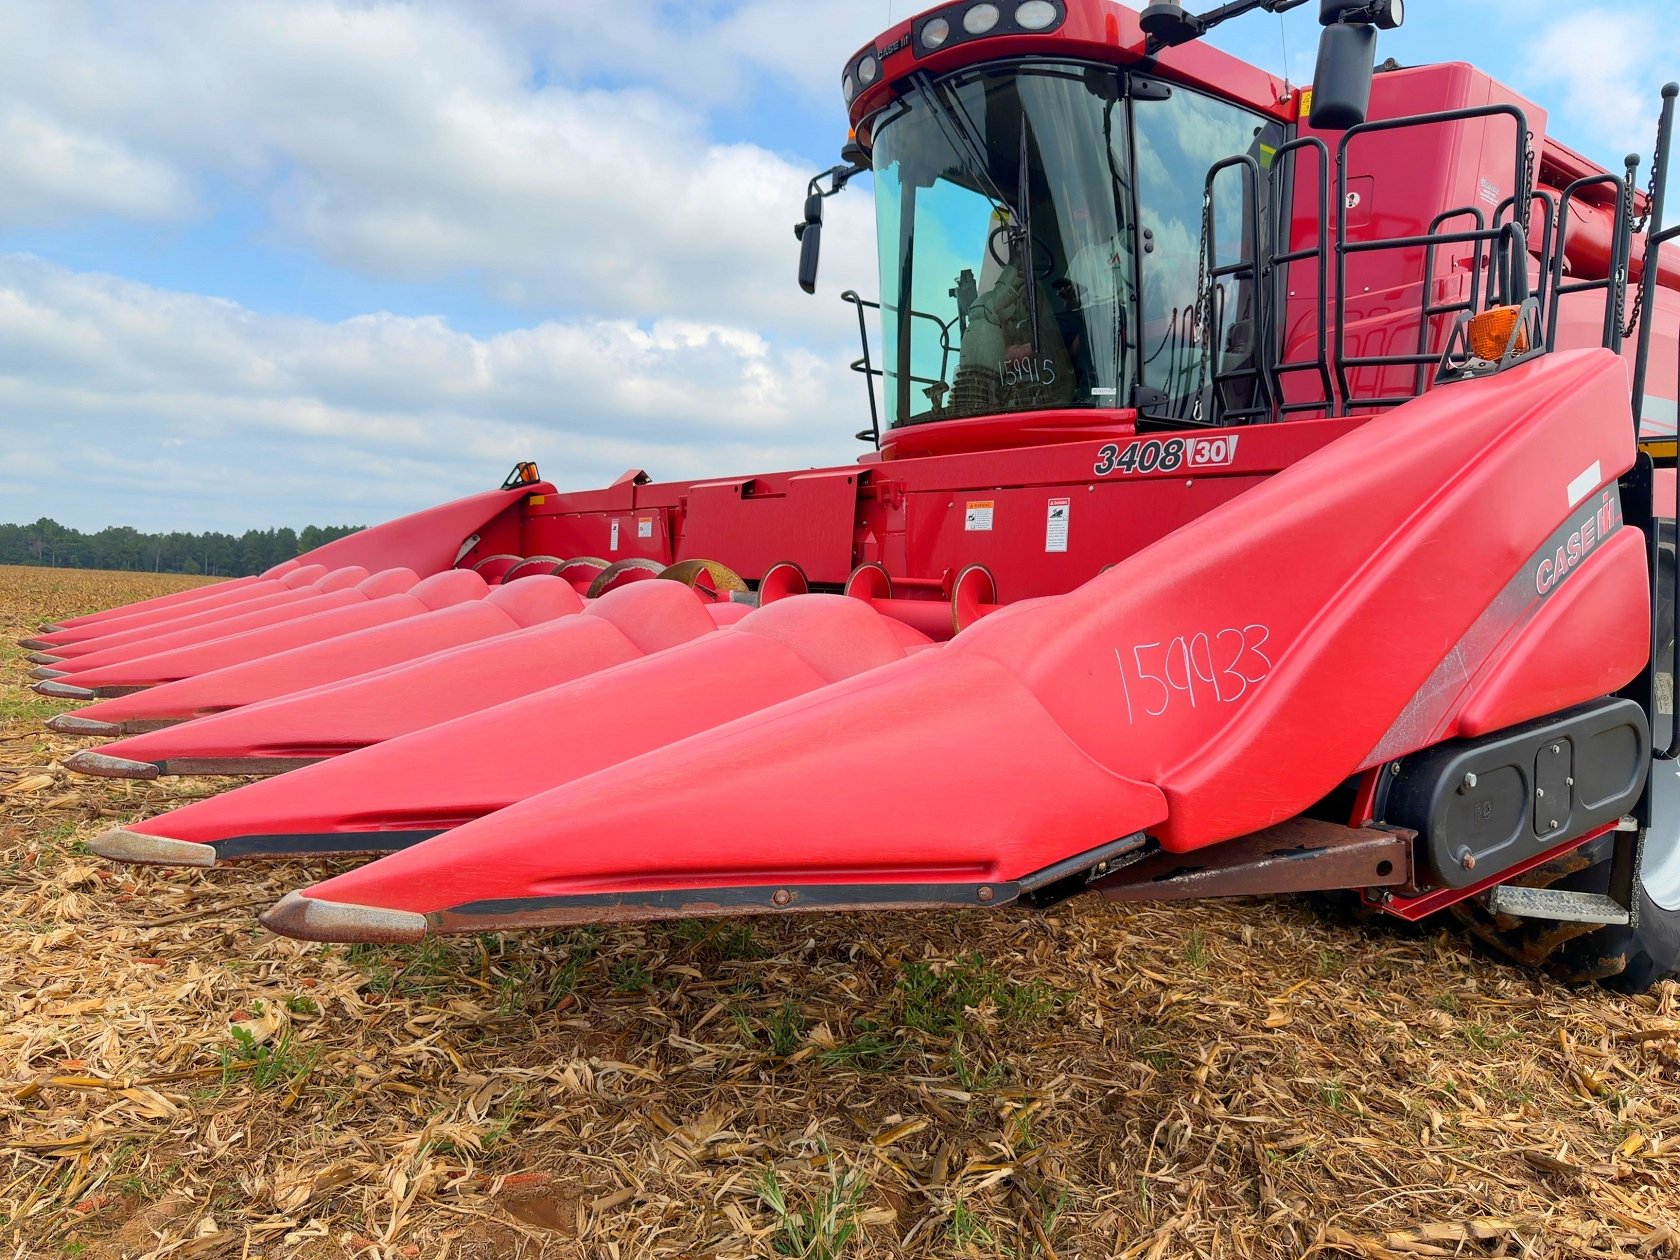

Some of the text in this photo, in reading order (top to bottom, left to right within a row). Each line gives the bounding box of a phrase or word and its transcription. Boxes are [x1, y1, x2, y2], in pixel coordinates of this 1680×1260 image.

[877, 40, 900, 60] CASE
[998, 356, 1056, 387] 159915
[1093, 437, 1227, 476] 3408 30
[1536, 516, 1596, 594] CASE
[1114, 624, 1272, 725] 159933
